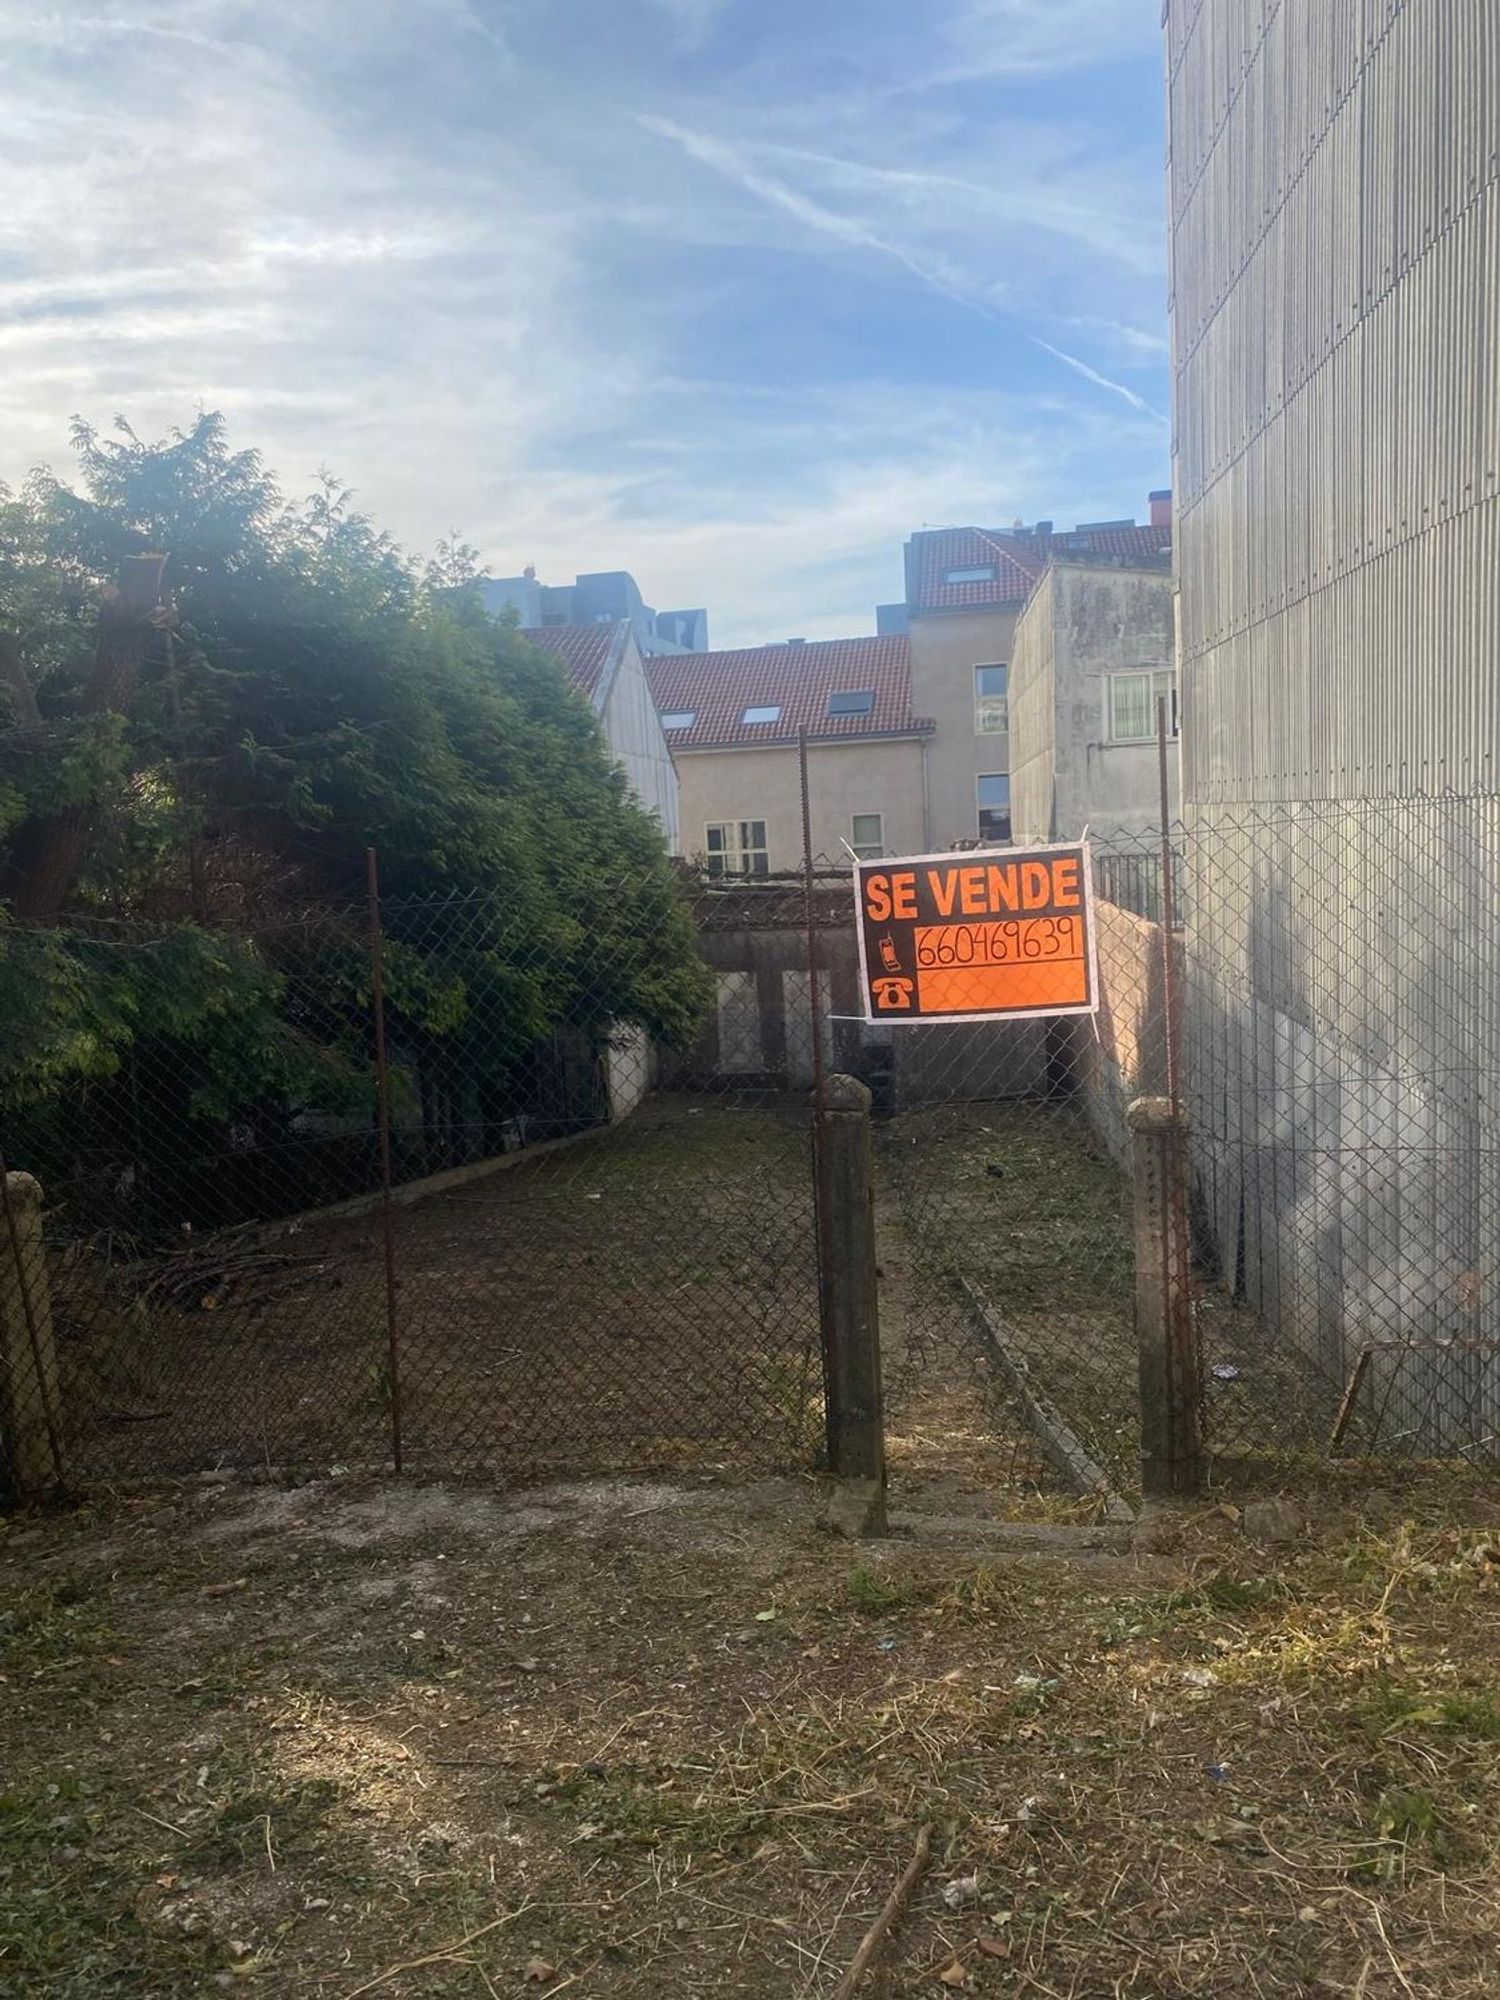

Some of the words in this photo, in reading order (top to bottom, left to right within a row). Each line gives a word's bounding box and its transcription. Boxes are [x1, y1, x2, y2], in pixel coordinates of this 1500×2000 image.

[866, 872, 918, 921] SE
[928, 858, 1080, 916] VENDE
[918, 917, 1075, 966] 660469639
